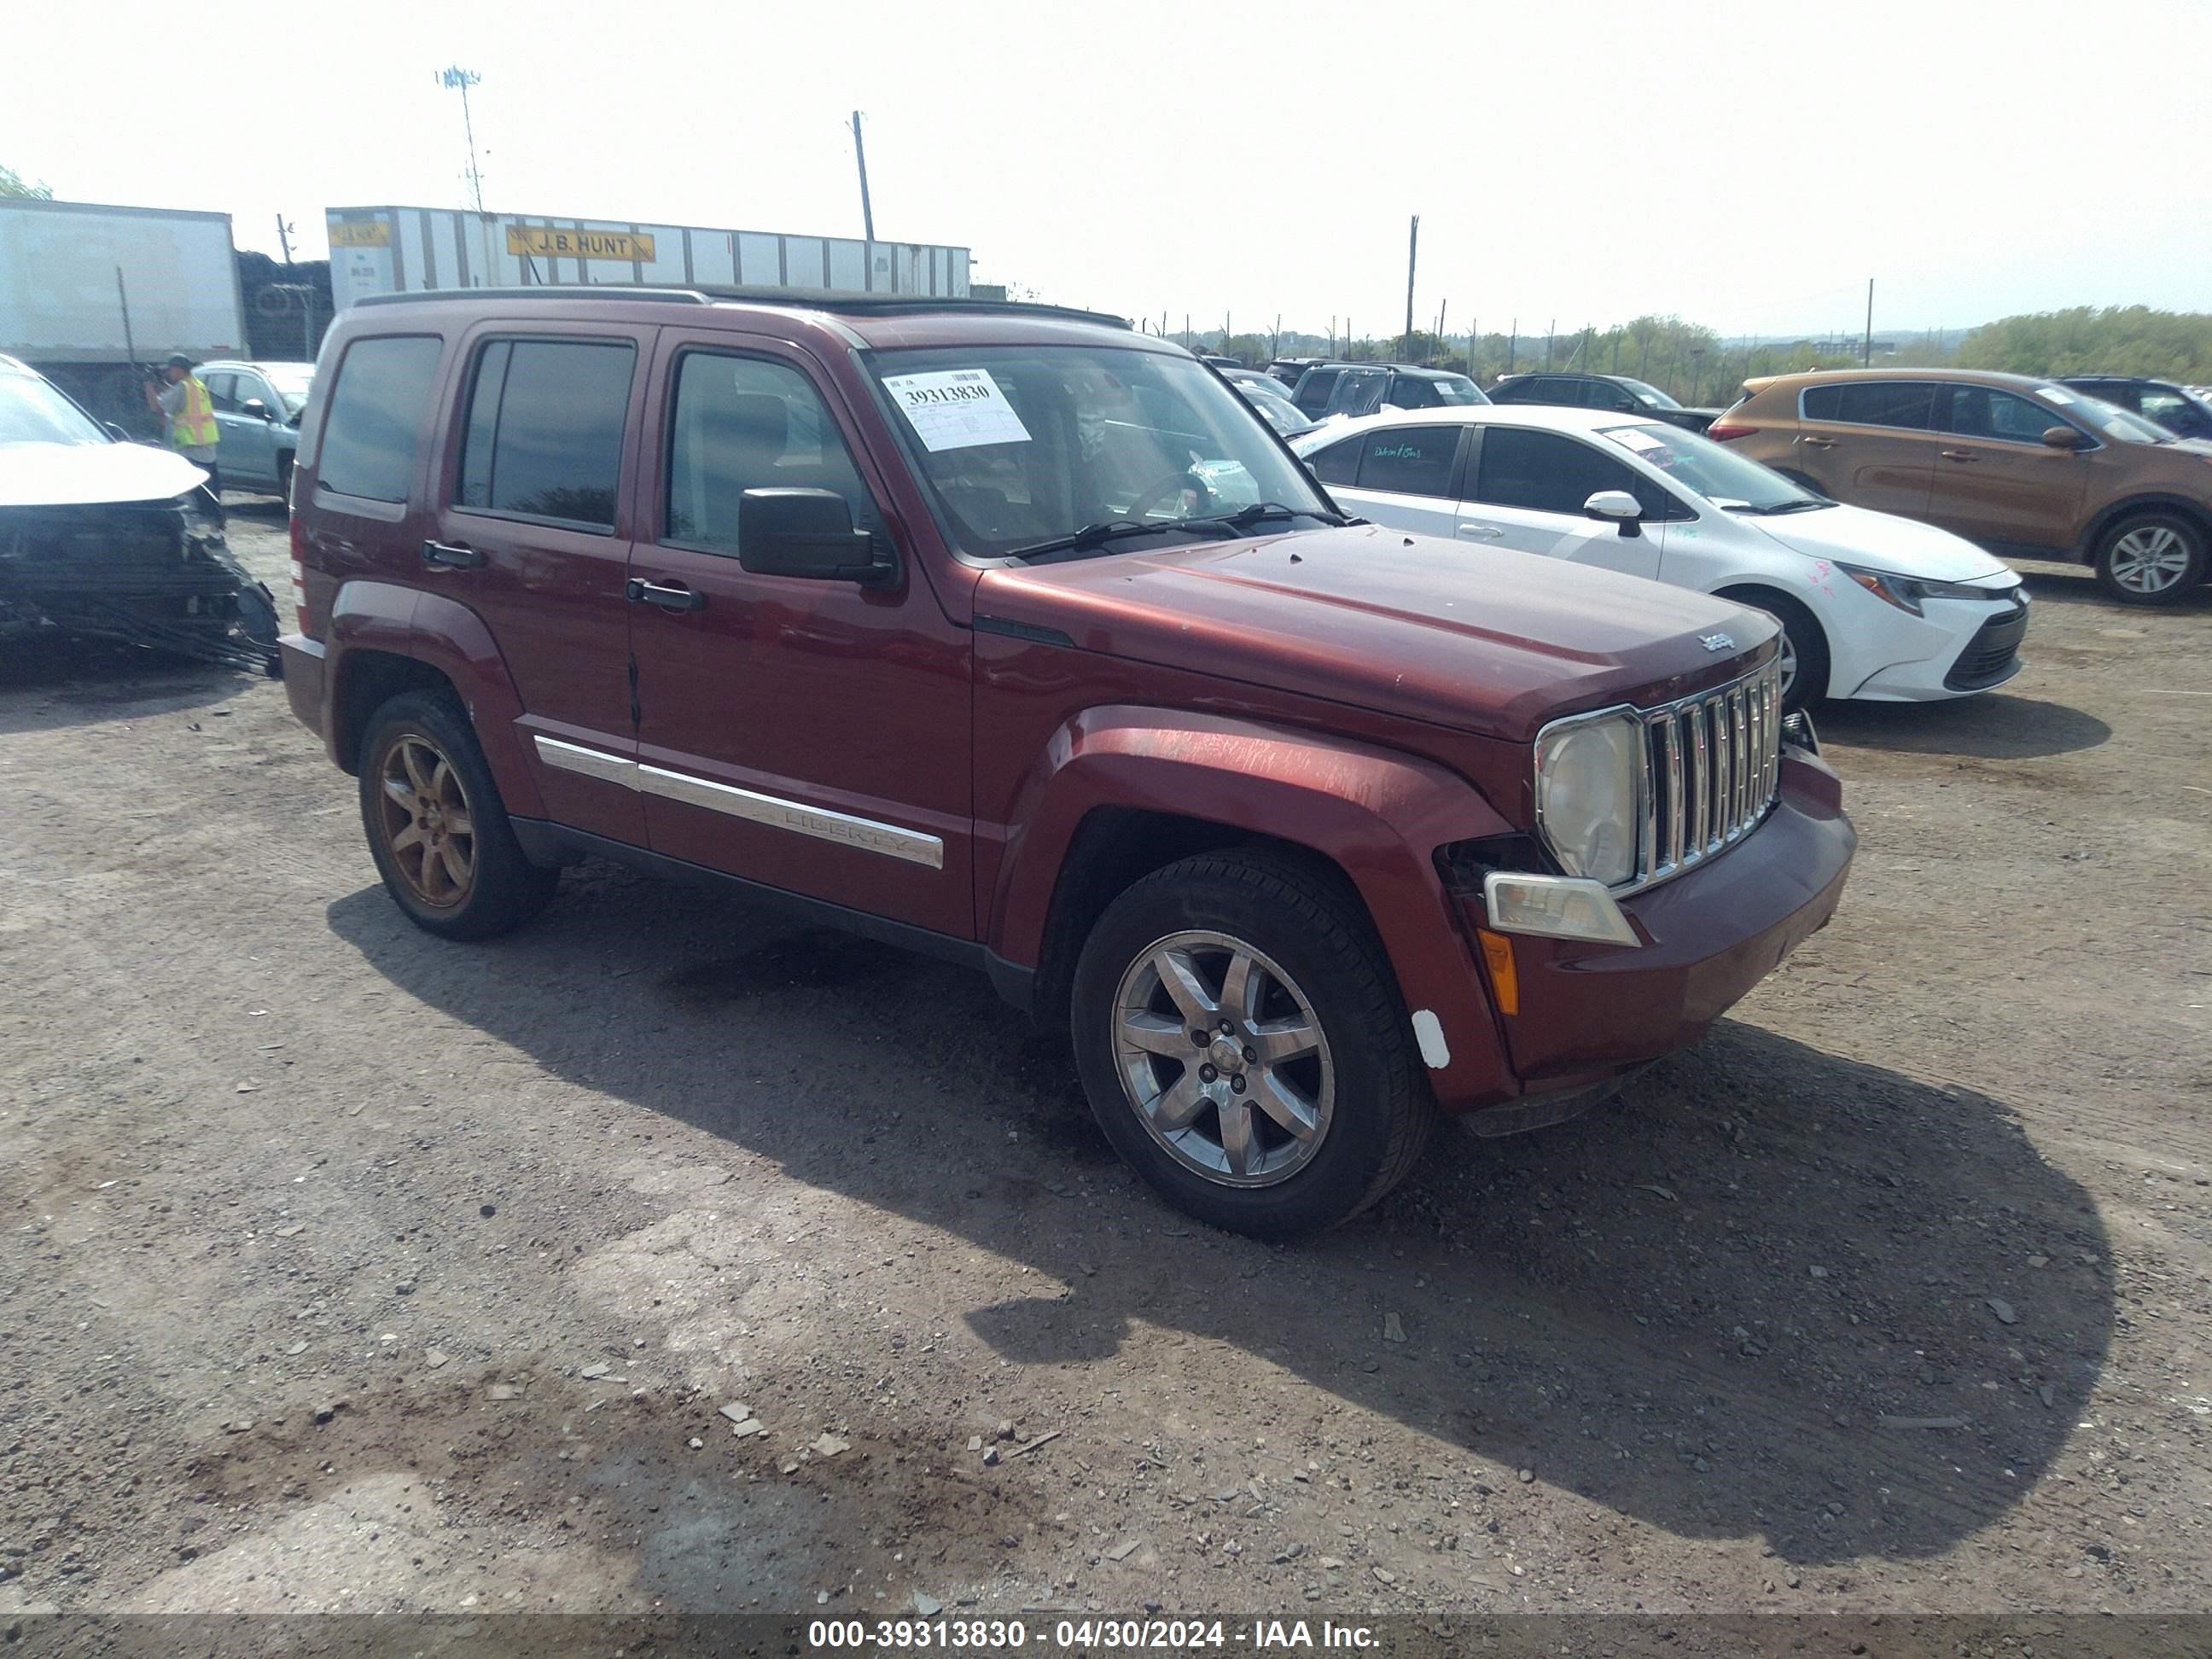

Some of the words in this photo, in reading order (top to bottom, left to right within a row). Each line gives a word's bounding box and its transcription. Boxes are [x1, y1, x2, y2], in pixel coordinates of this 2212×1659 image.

[578, 236, 627, 255] HUNT
[905, 385, 990, 406] 39313830
[785, 812, 910, 852] LIBERTY
